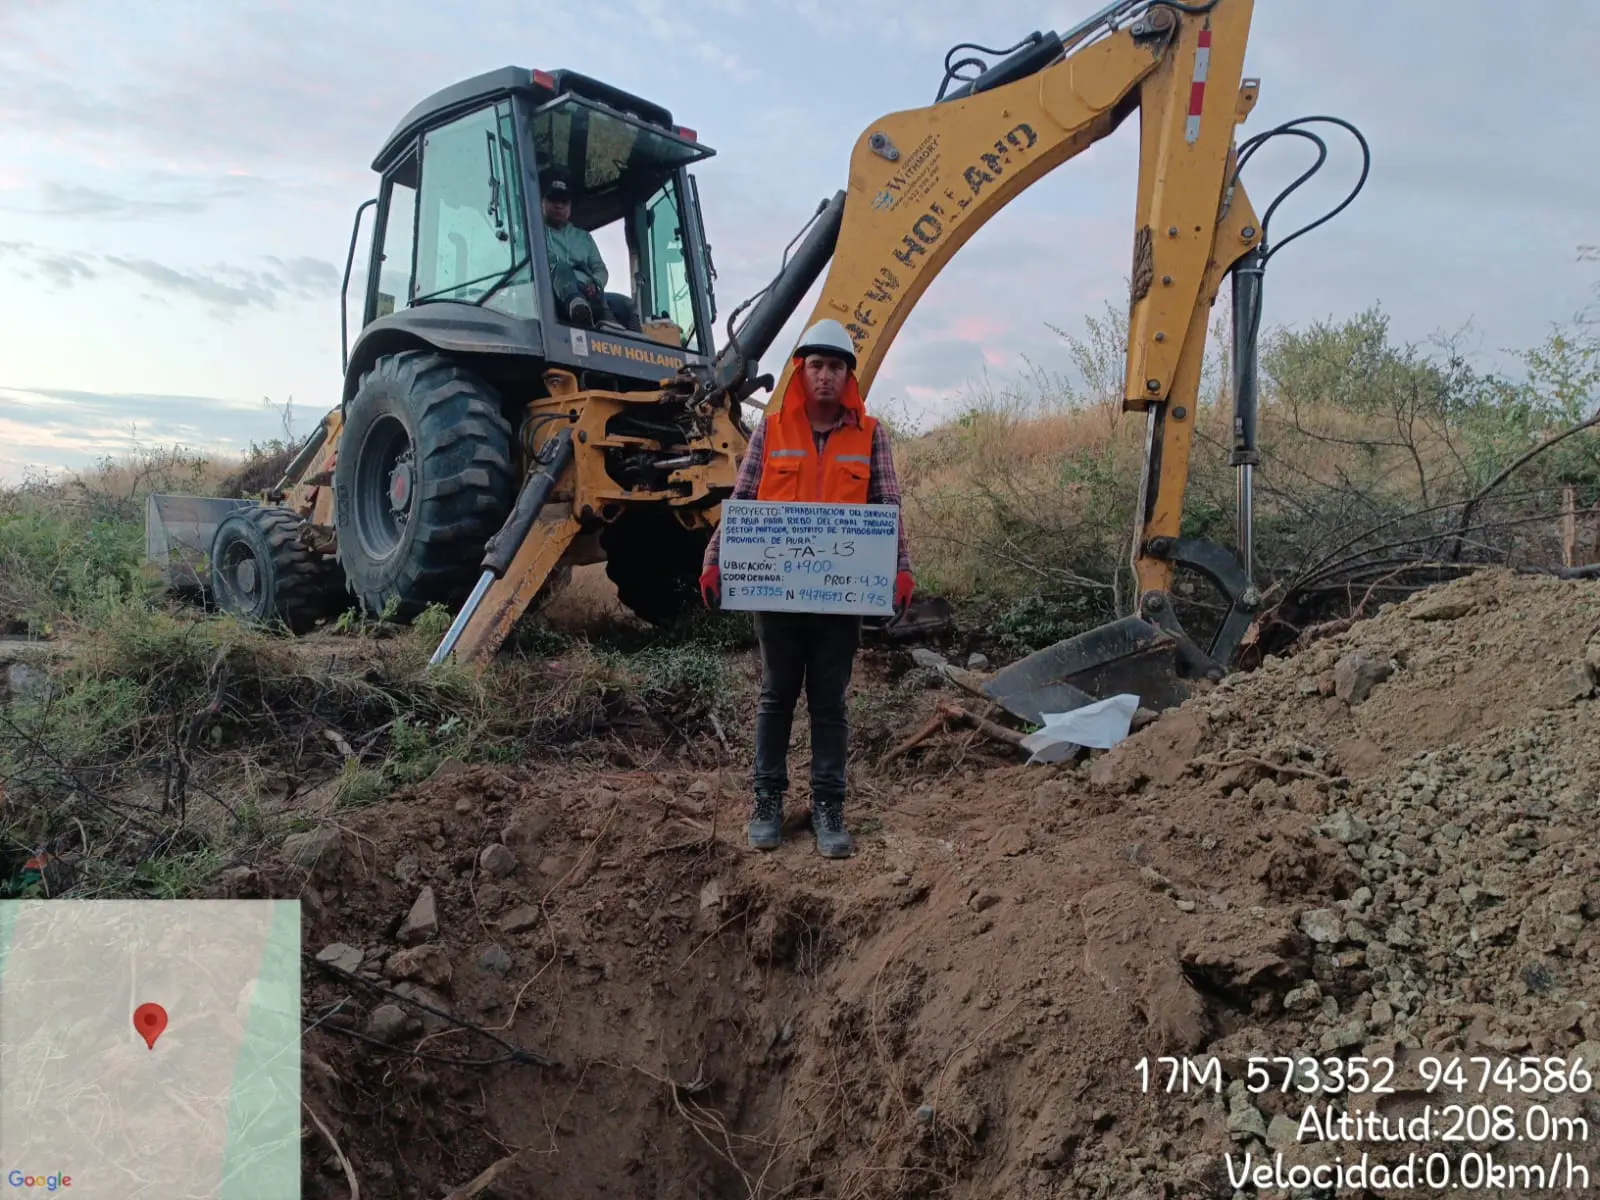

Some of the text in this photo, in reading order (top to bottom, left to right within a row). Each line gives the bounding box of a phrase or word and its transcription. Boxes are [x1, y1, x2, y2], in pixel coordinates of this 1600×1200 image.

[591, 340, 684, 369] NEW HOLLAND
[849, 509, 862, 517] DEL
[863, 510, 897, 519] SERVICIO
[727, 517, 737, 525] DE
[763, 516, 783, 525] PARA
[817, 517, 831, 526] DEL
[834, 518, 858, 526] CANAL
[725, 526, 753, 534] SECTOR
[792, 526, 824, 534] DISTRITO
[725, 535, 766, 544] PROVINCIA
[771, 536, 782, 545] DE
[783, 560, 832, 574] 8+900
[824, 574, 857, 586] PROF:
[785, 589, 795, 601] N
